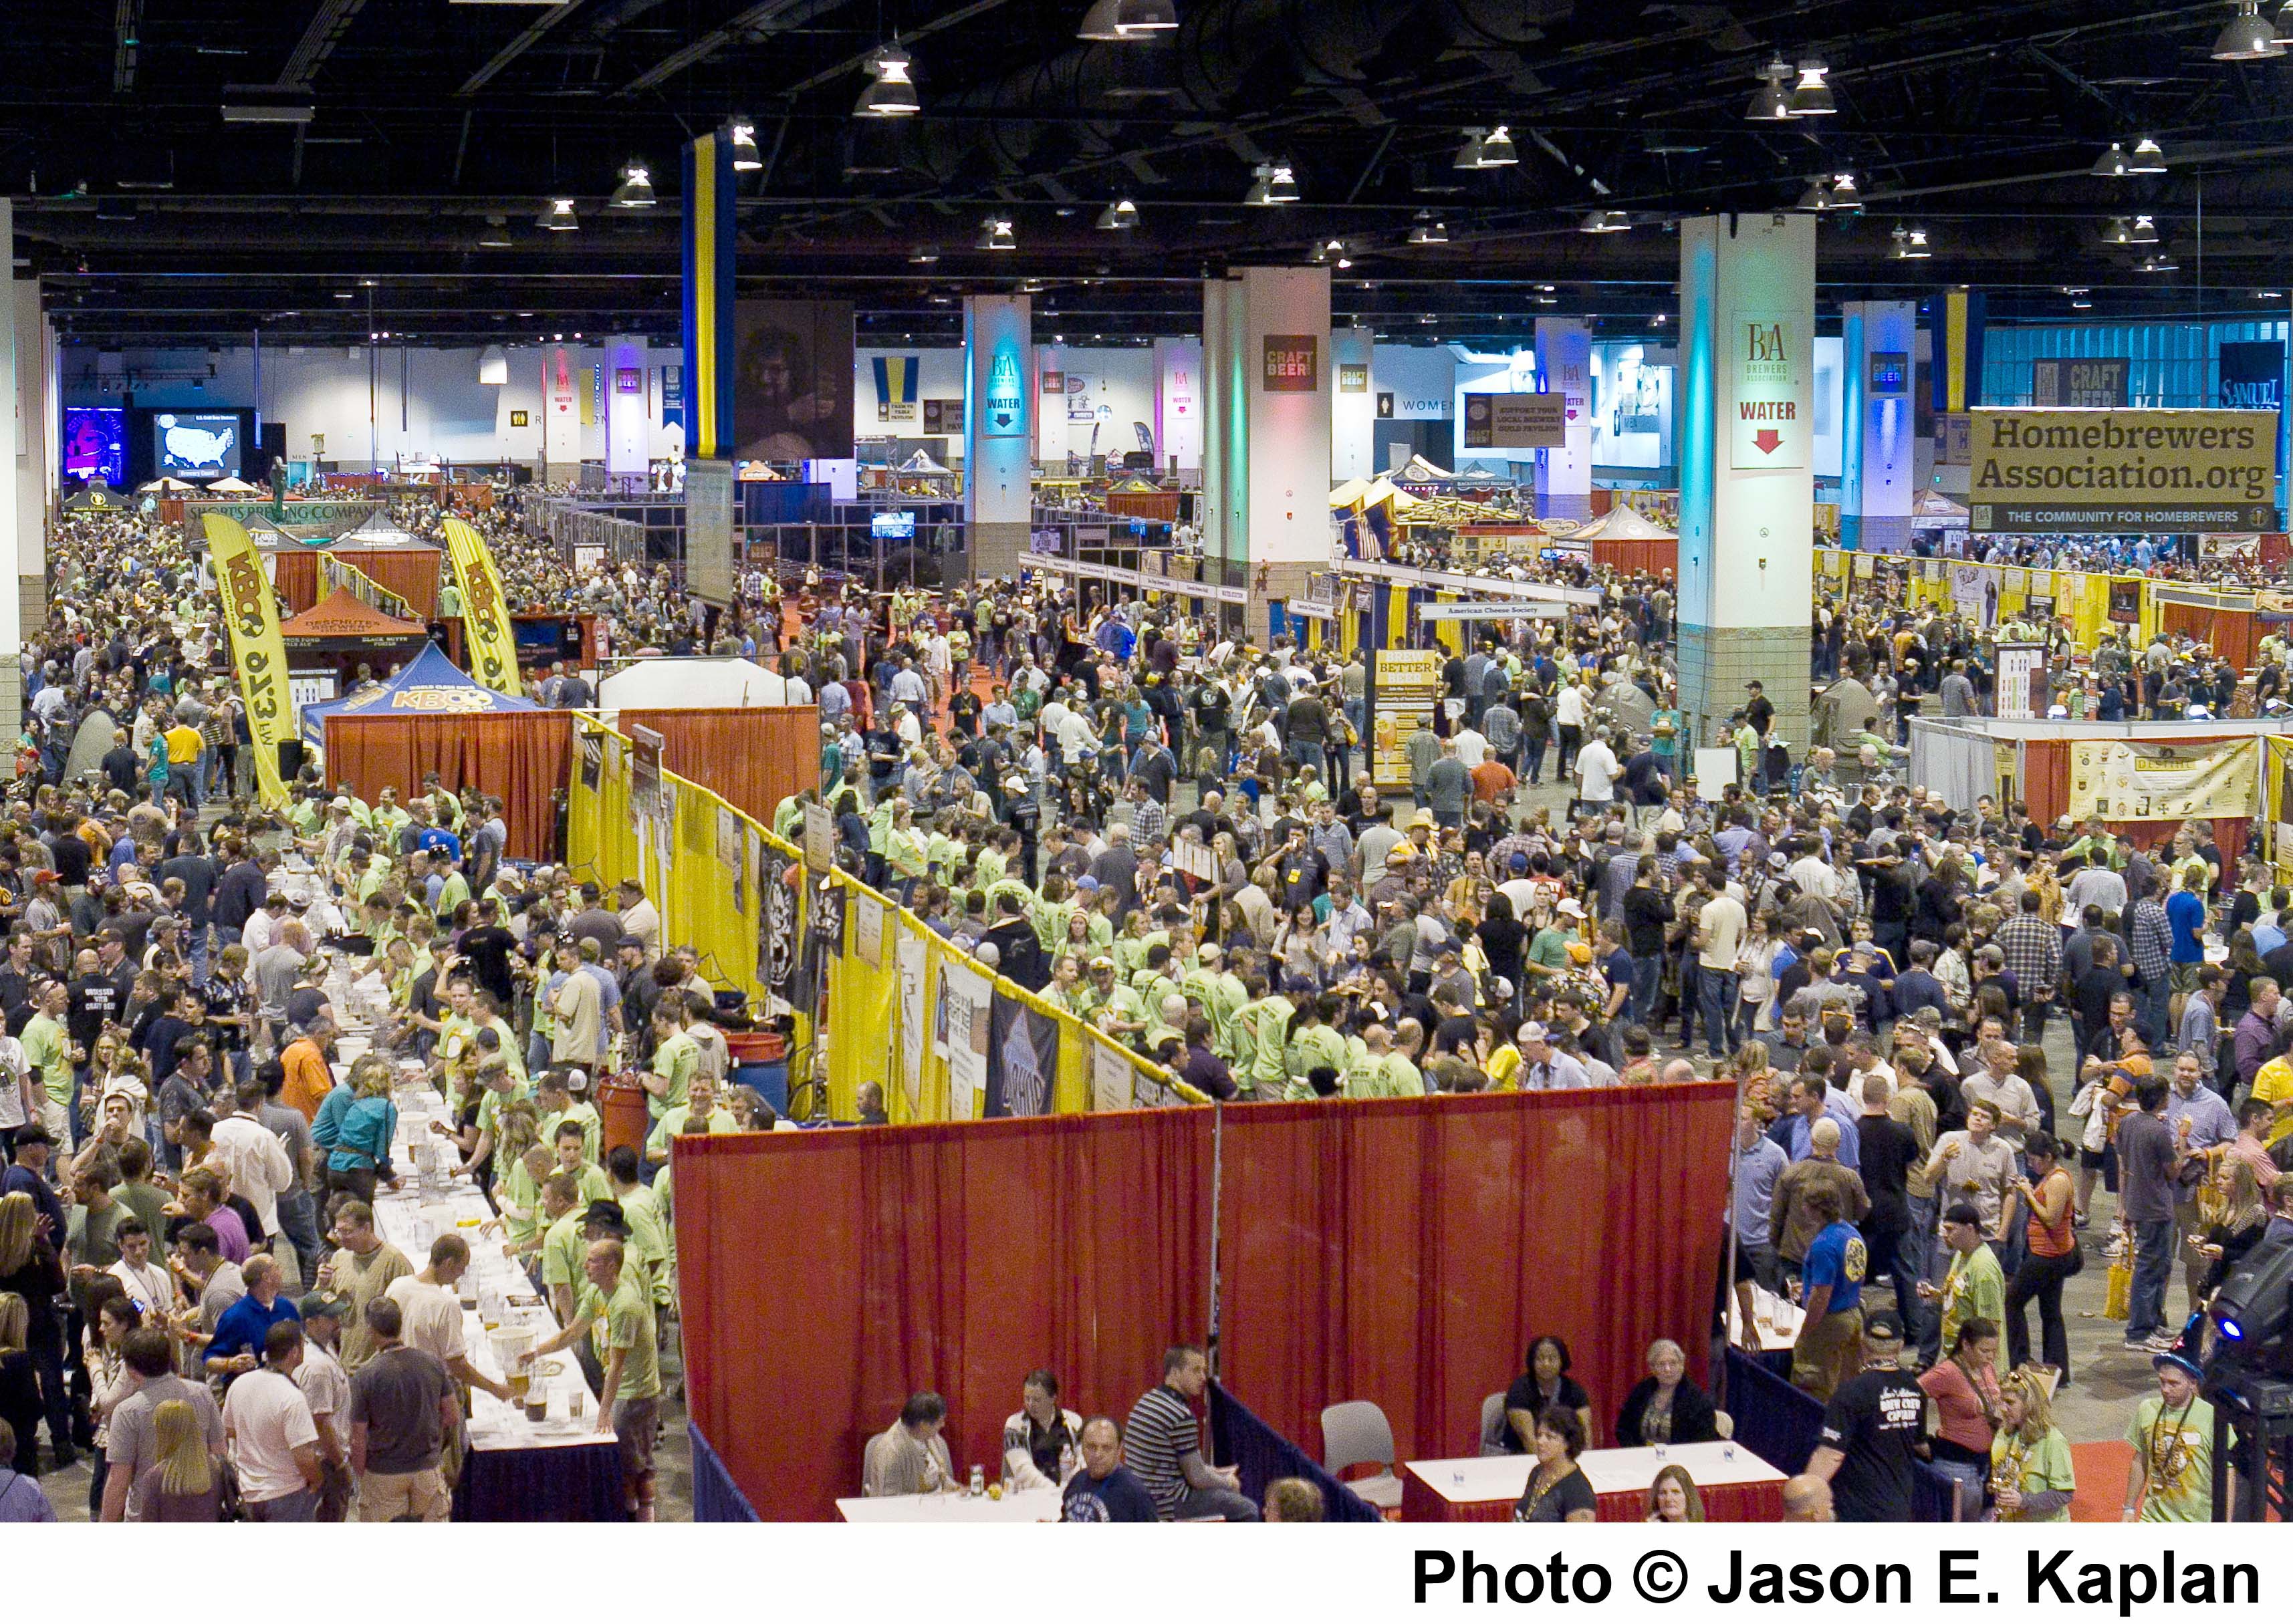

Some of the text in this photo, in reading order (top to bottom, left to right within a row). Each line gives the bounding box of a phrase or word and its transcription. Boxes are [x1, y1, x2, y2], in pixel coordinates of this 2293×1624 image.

[1267, 351, 1312, 364] CRAFT
[1746, 364, 1787, 374] BREWERS
[1873, 363, 1905, 372] CRAFT
[2071, 364, 2121, 390] CRAFT
[2221, 379, 2280, 408] SAMUEL
[987, 398, 1020, 409] WATER
[1565, 398, 1584, 406] ATER
[1739, 402, 1796, 420] WATER
[1992, 418, 2255, 449] Homebrewers
[1977, 456, 2268, 500] Association.org
[2008, 511, 2239, 523] THE COMMUNITY FOR HOMEBREWERS
[1385, 652, 1426, 663] BREW
[1379, 663, 1433, 673] BETTER
[1387, 673, 1423, 684] BEER
[85, 1002, 116, 1010] CRAFT BEER
